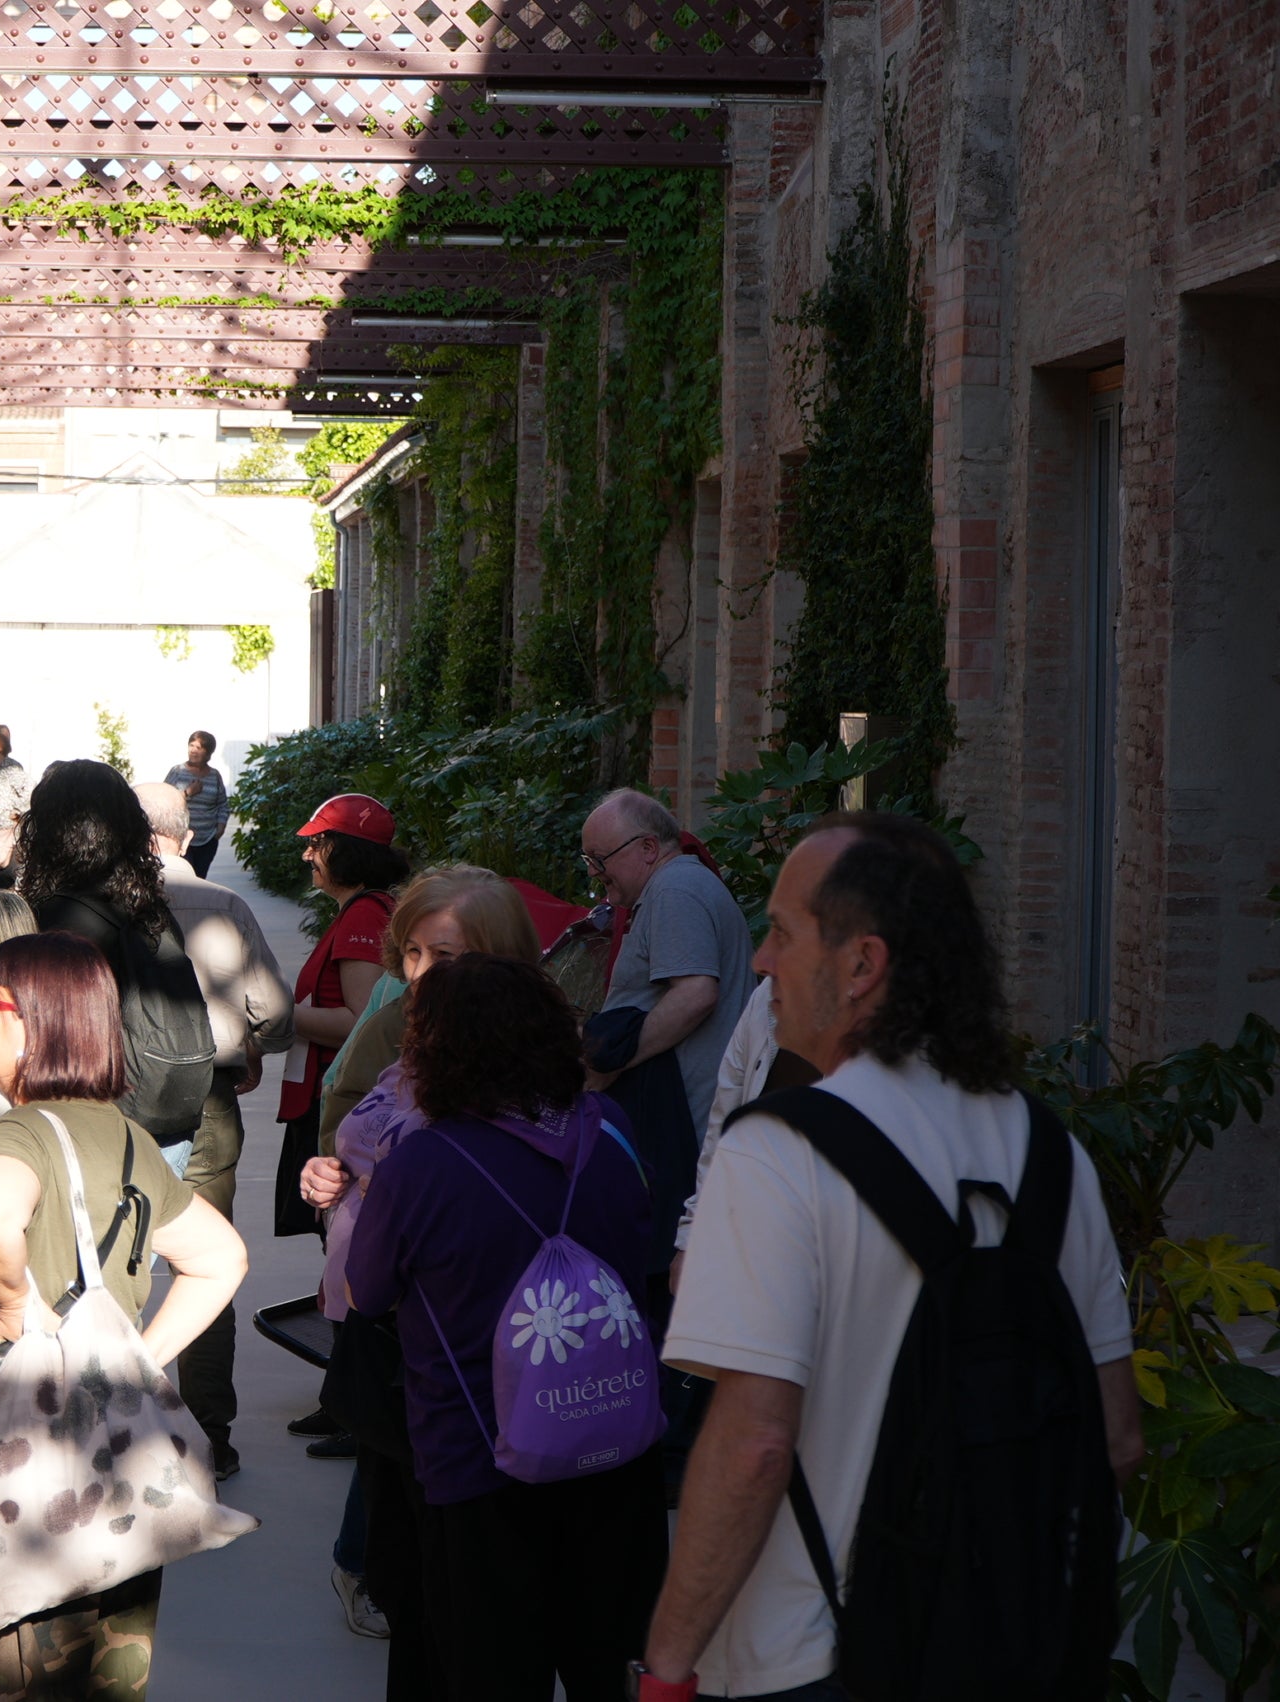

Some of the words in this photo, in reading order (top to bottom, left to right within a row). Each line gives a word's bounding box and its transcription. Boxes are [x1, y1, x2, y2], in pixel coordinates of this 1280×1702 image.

[535, 1368, 648, 1414] quiérete
[559, 1407, 590, 1422] CADA
[592, 1402, 610, 1416] DÍA
[611, 1396, 632, 1411] MÁS
[580, 1450, 616, 1466] ALE-HOP
